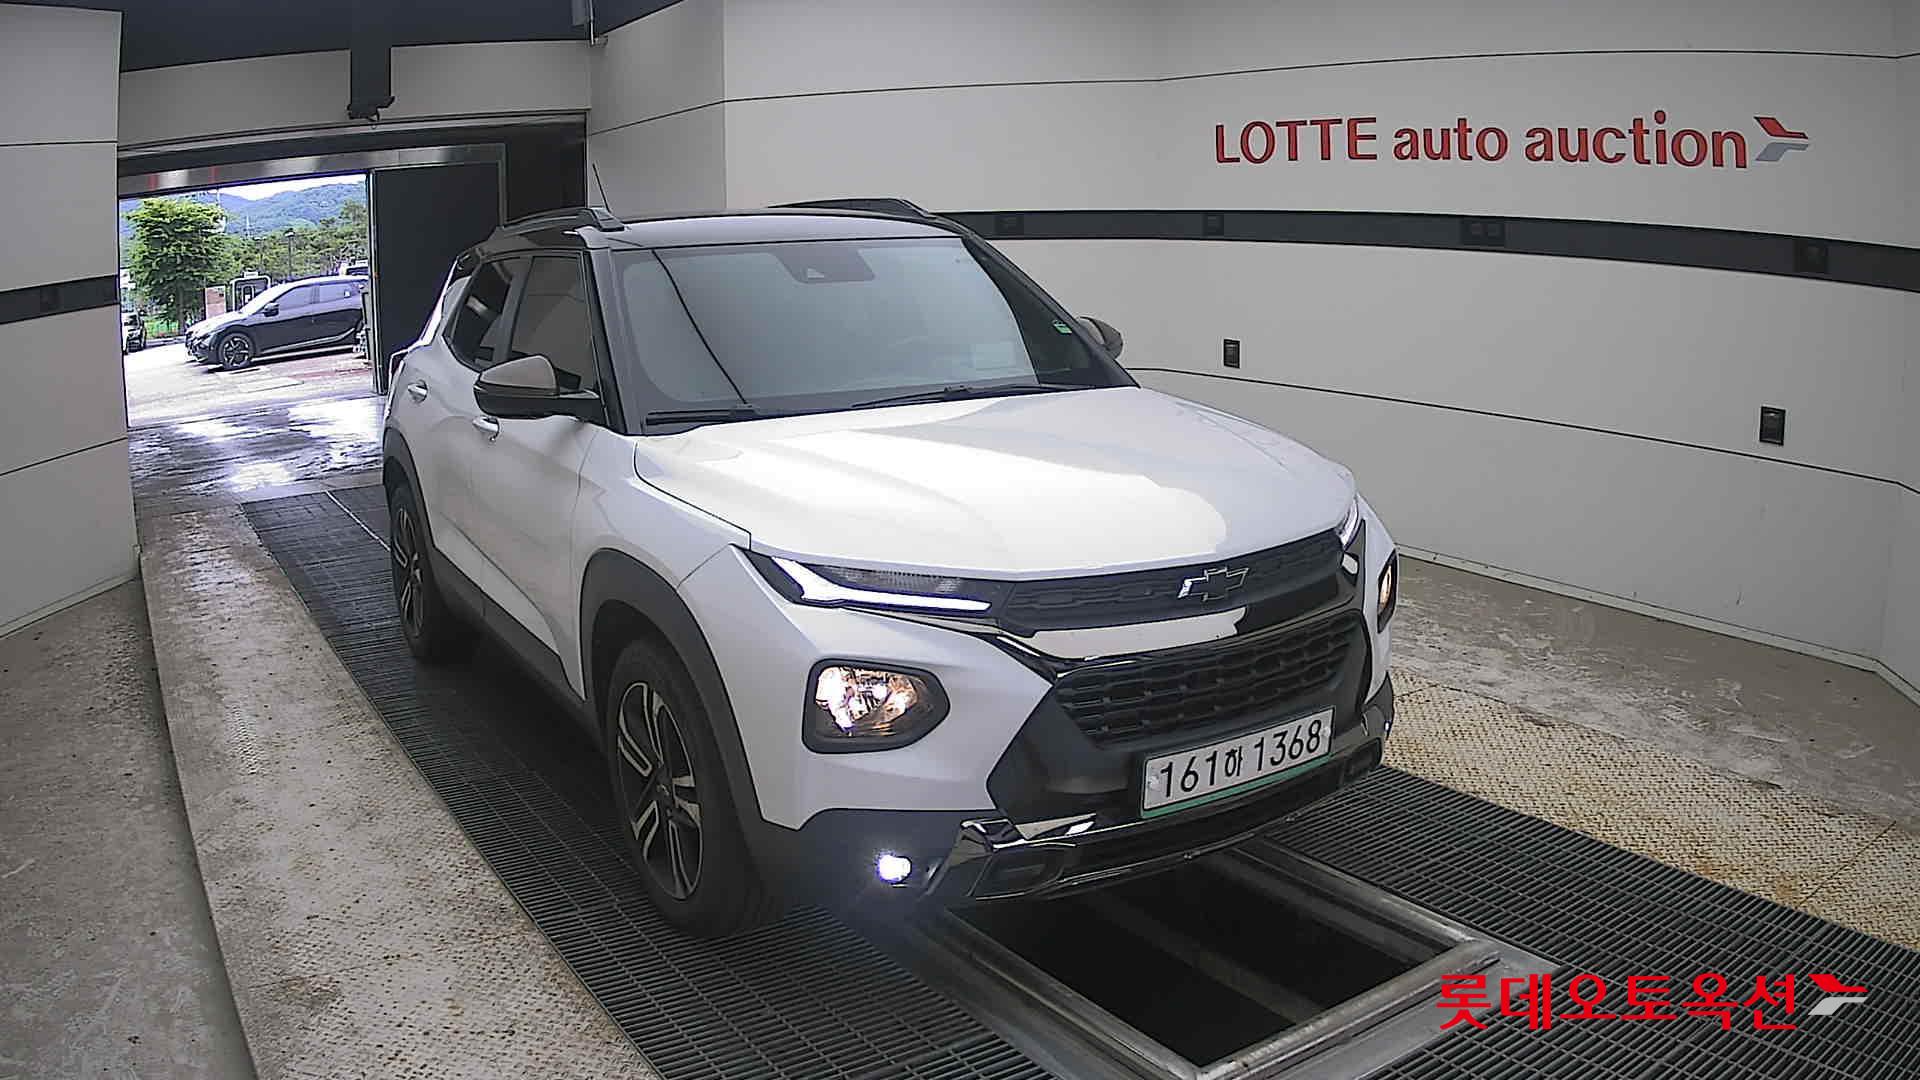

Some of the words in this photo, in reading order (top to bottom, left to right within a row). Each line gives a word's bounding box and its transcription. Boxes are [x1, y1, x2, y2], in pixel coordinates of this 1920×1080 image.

[1215, 117, 1378, 164] LOTTE
[1393, 117, 1509, 161] auto
[1524, 109, 1748, 169] auction
[1160, 745, 1243, 798] 161하
[1254, 719, 1322, 772] 1368
